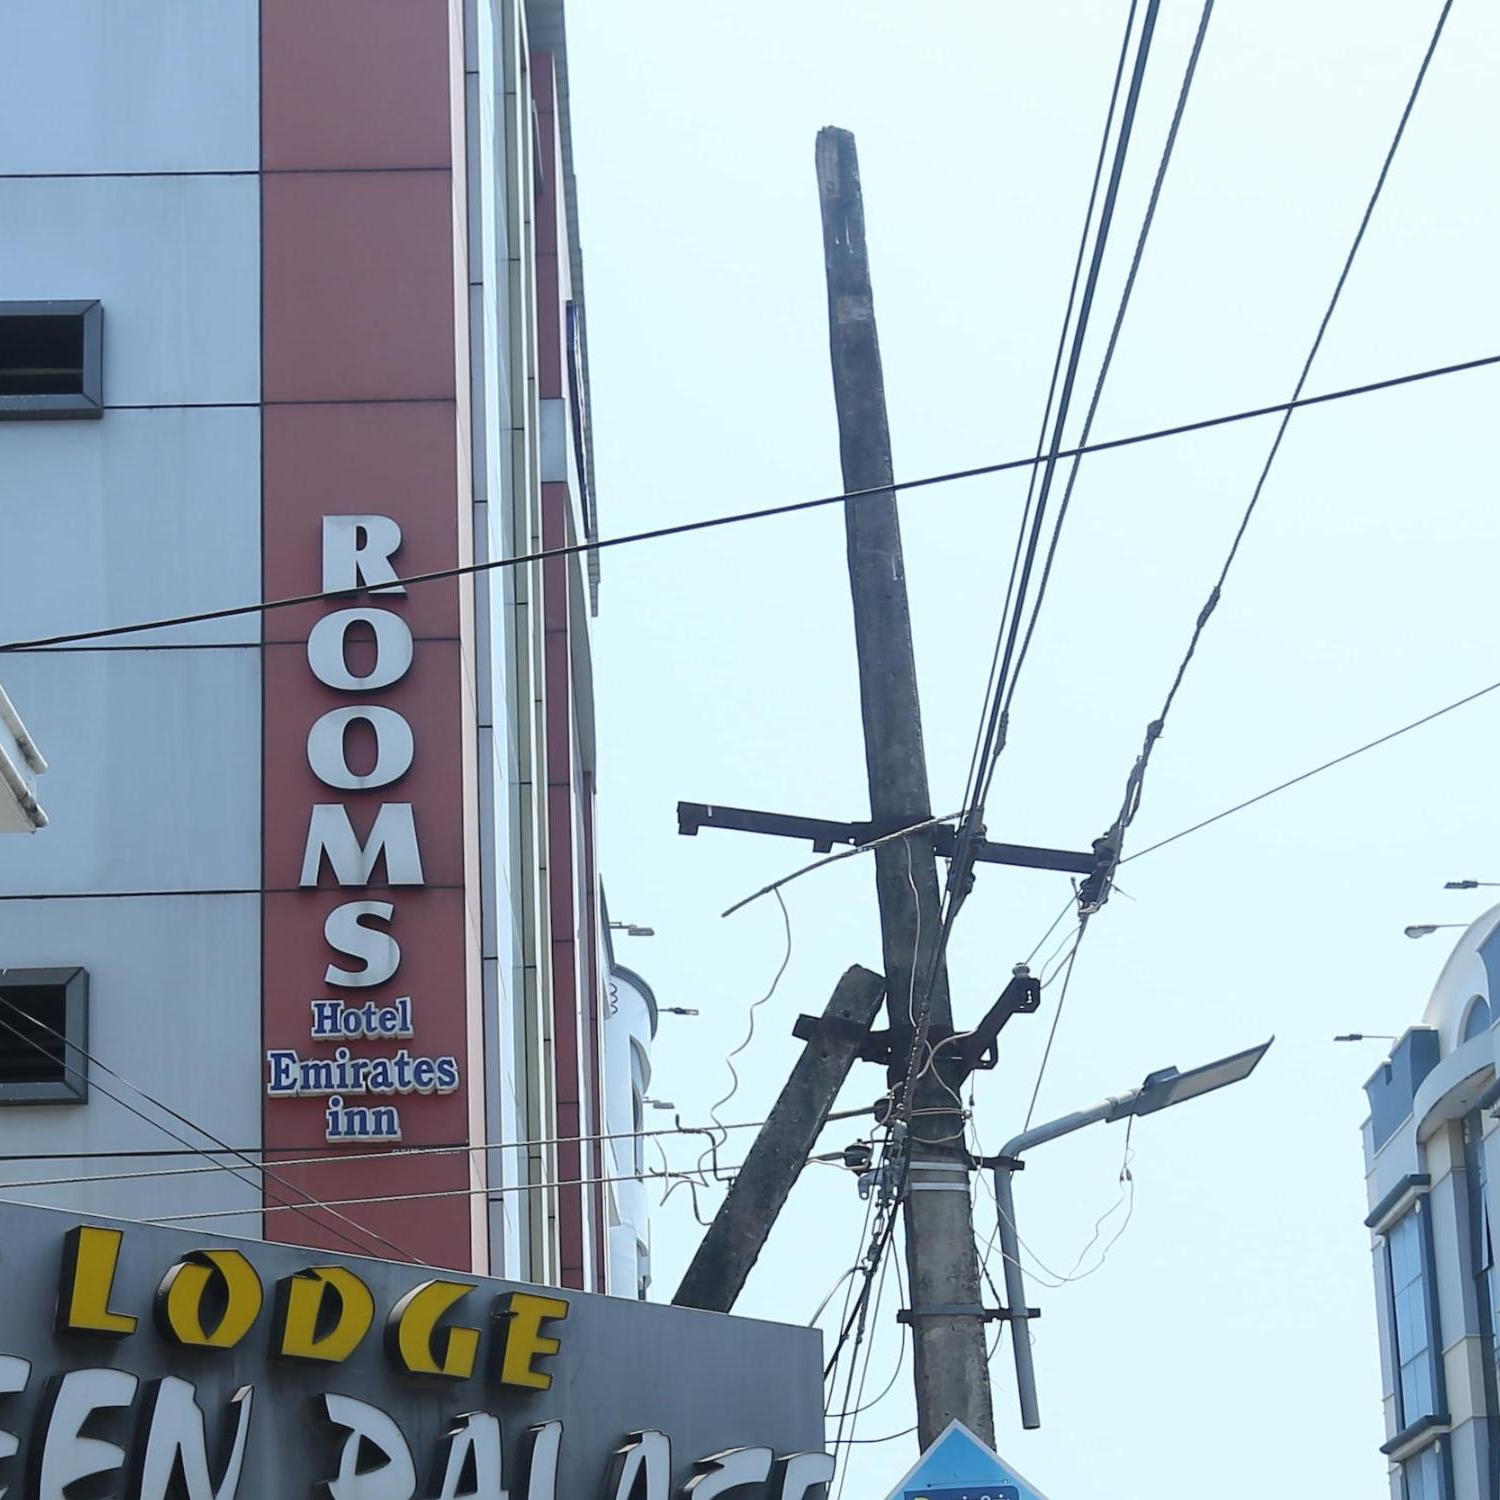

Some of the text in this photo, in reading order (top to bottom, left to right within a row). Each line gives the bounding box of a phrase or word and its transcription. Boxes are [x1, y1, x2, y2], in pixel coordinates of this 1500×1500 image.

[299, 513, 426, 986] ROOMS
[311, 997, 411, 1039] Hotel
[267, 1049, 458, 1096] Emirates
[325, 1096, 401, 1141] inn
[60, 1225, 570, 1392] LODGE
